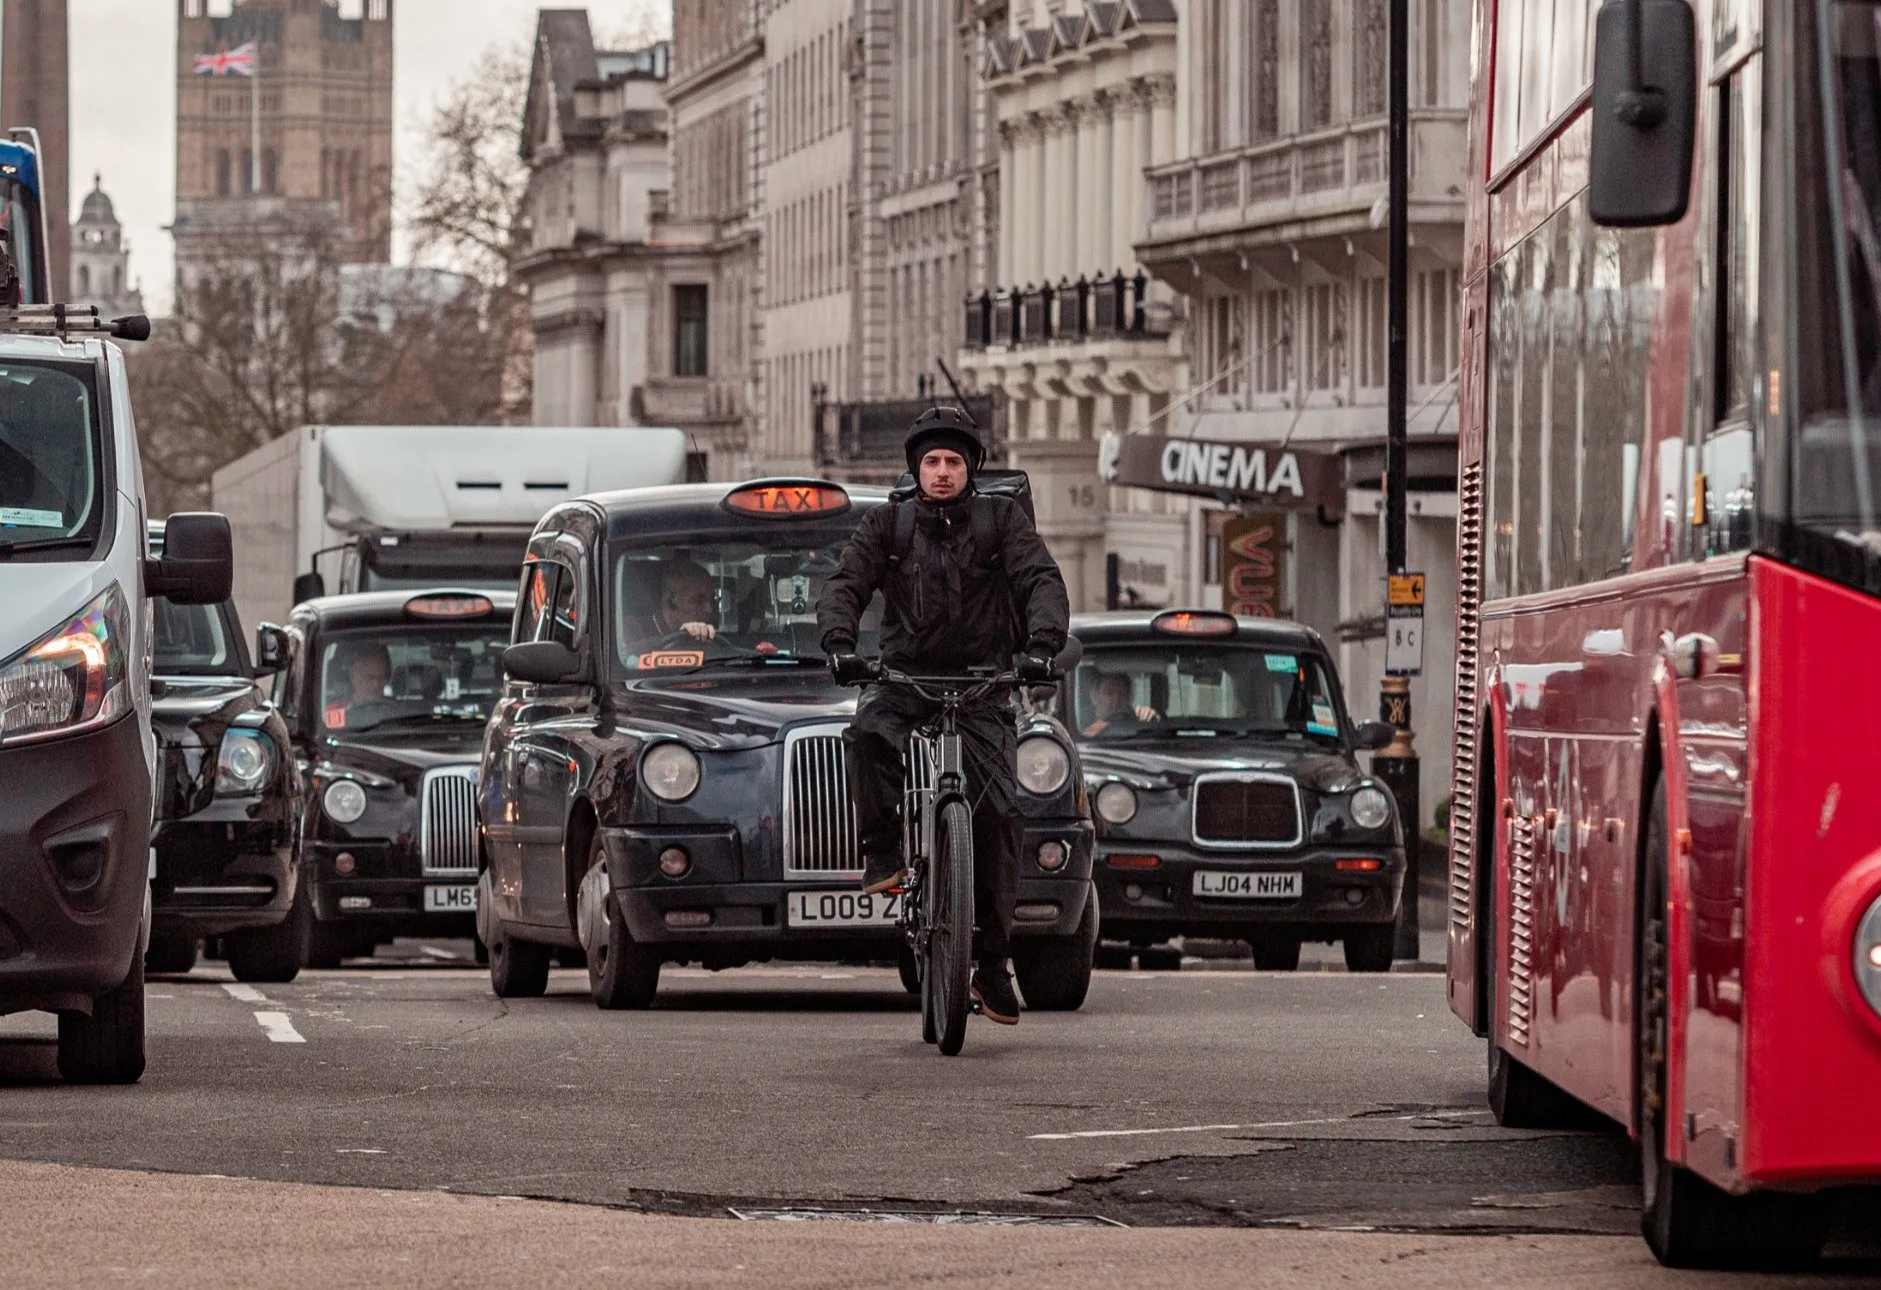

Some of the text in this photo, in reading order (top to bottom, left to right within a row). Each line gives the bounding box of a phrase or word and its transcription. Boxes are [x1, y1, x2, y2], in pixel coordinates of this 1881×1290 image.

[1161, 440, 1304, 497] CINEMA
[753, 489, 824, 510] TAXI
[1201, 875, 1295, 894] LJ04 NHM
[434, 888, 478, 907] LM6
[801, 894, 874, 921] LO09
